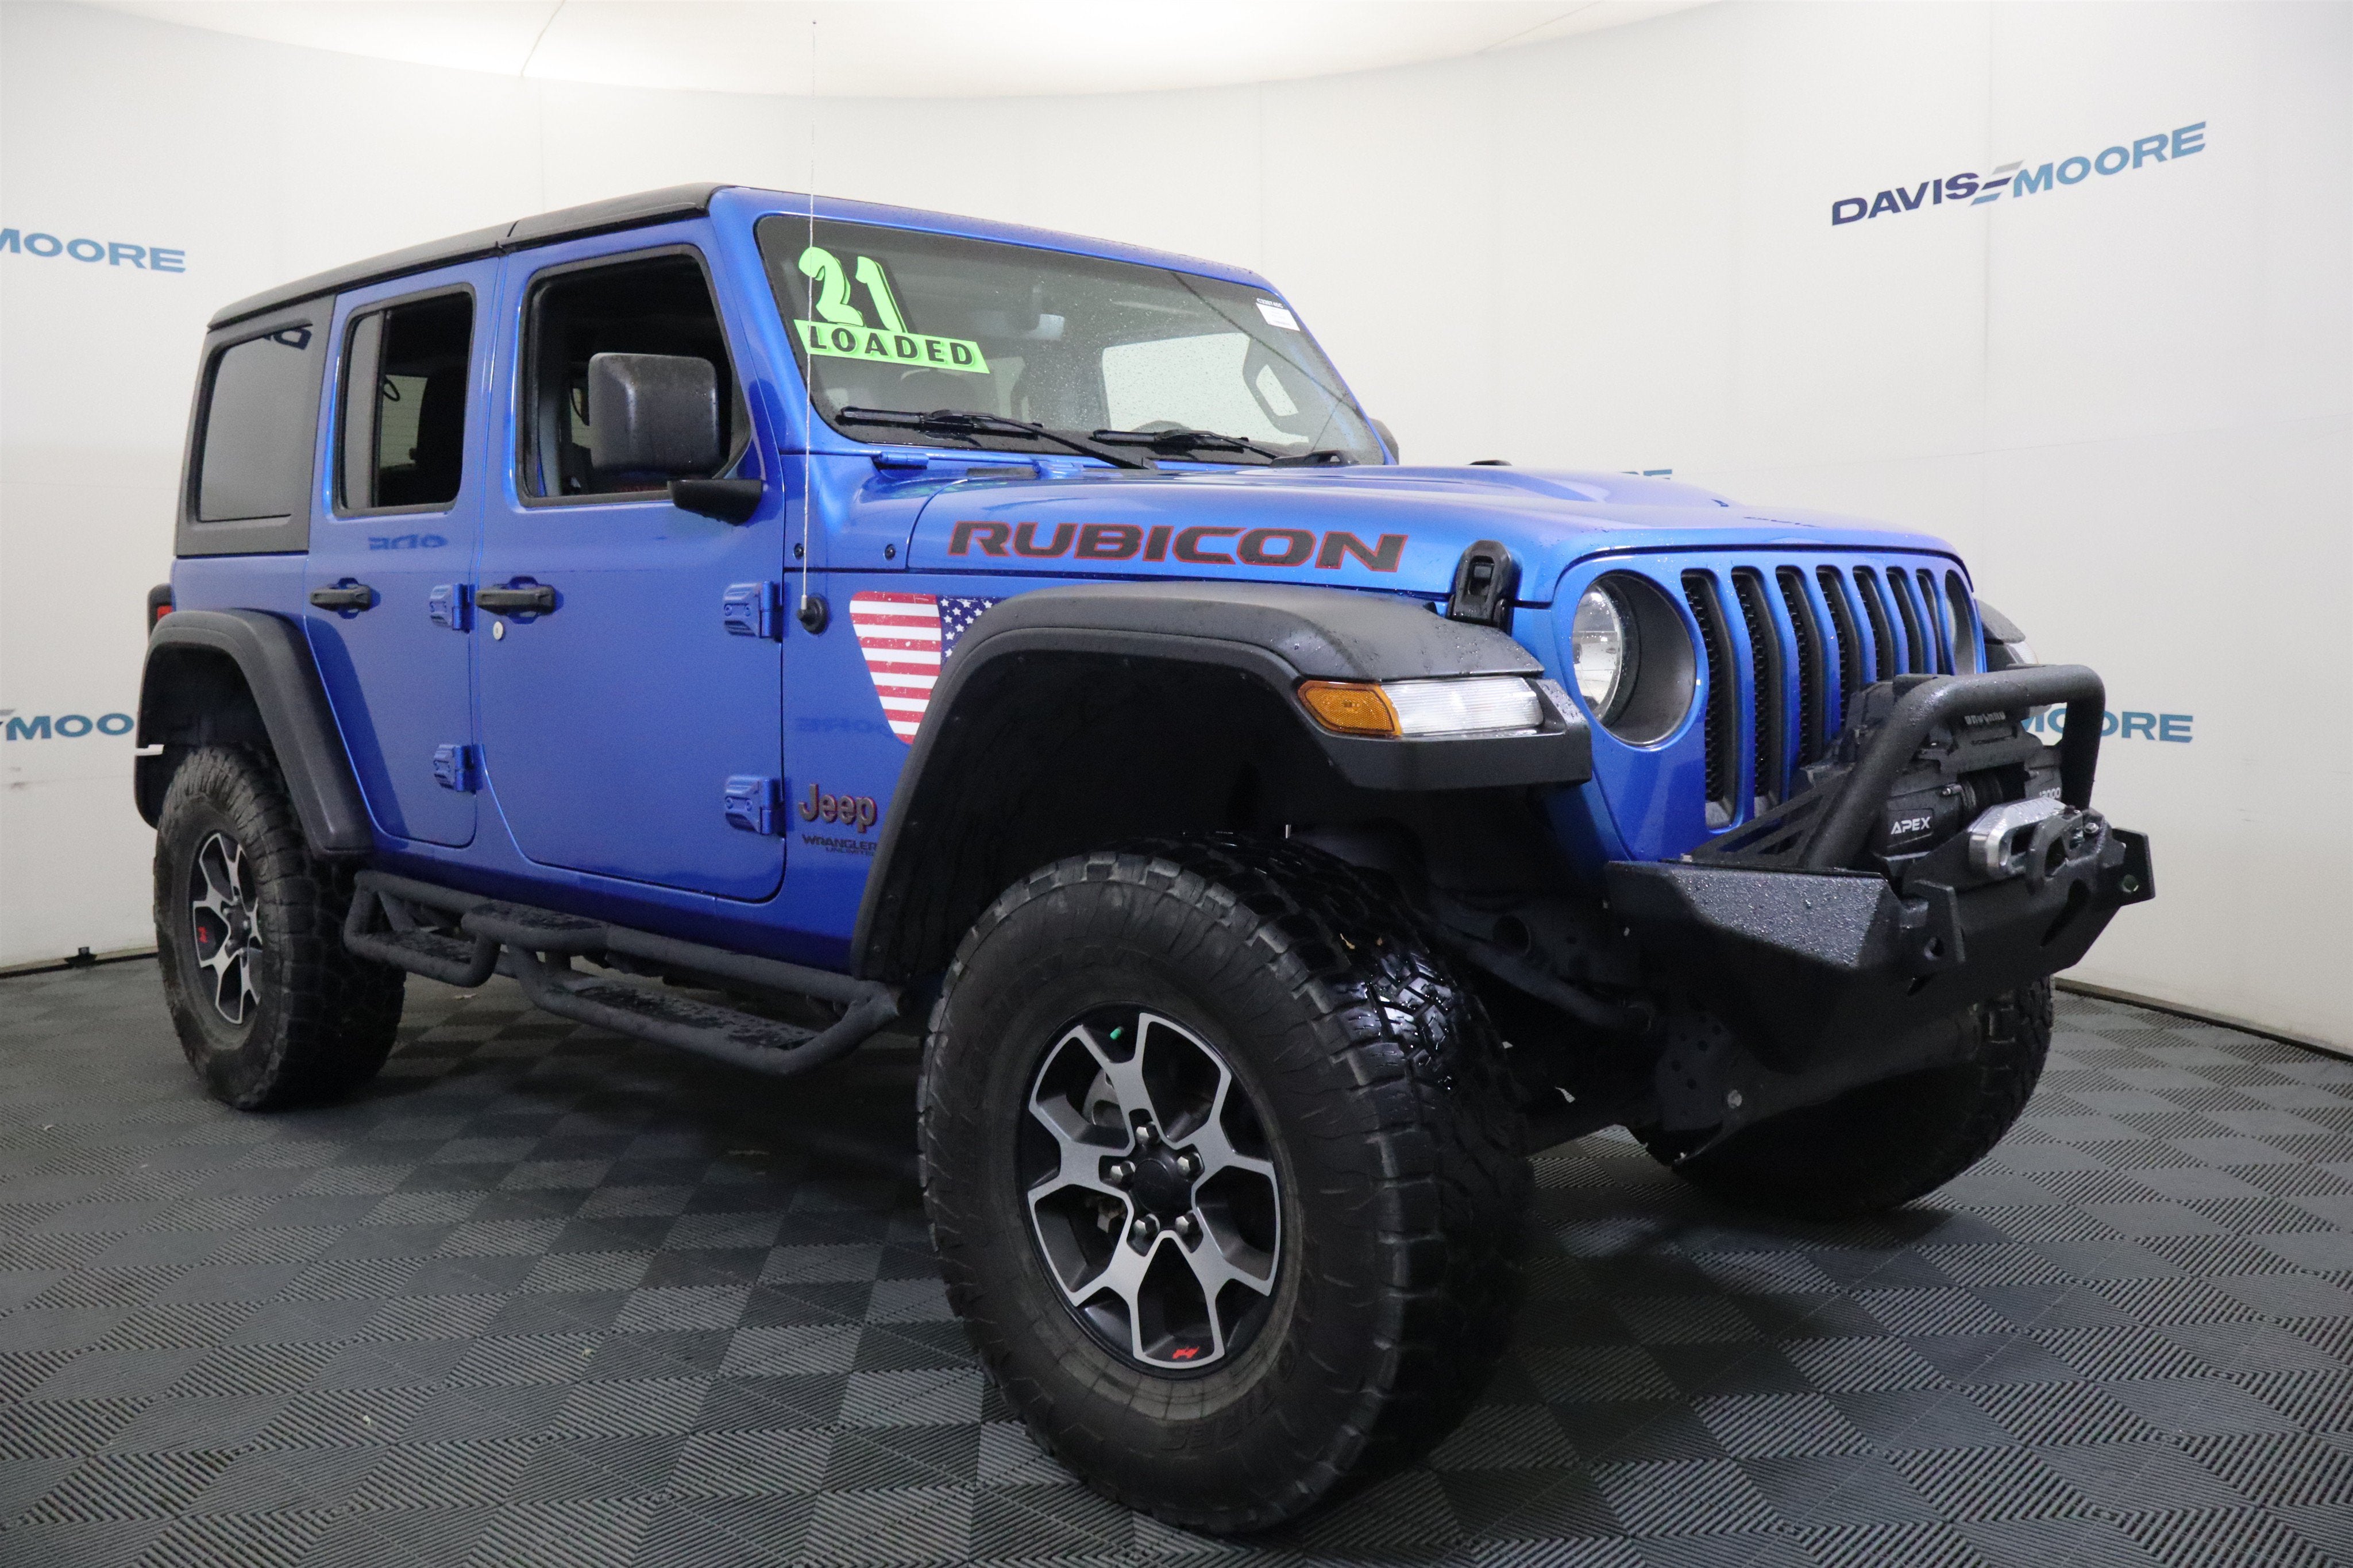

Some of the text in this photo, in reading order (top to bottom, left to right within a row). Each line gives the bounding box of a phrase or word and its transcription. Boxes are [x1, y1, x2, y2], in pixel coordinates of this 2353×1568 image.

[1832, 121, 2206, 226] DAVIS MOORE
[798, 246, 908, 333] 21
[807, 325, 974, 365] LOADED
[948, 521, 1409, 572] RUBICON
[5, 713, 134, 741] MOO
[799, 783, 877, 833] Jeep
[1890, 816, 1931, 835] APEX
[802, 834, 878, 851] WRANGLER
